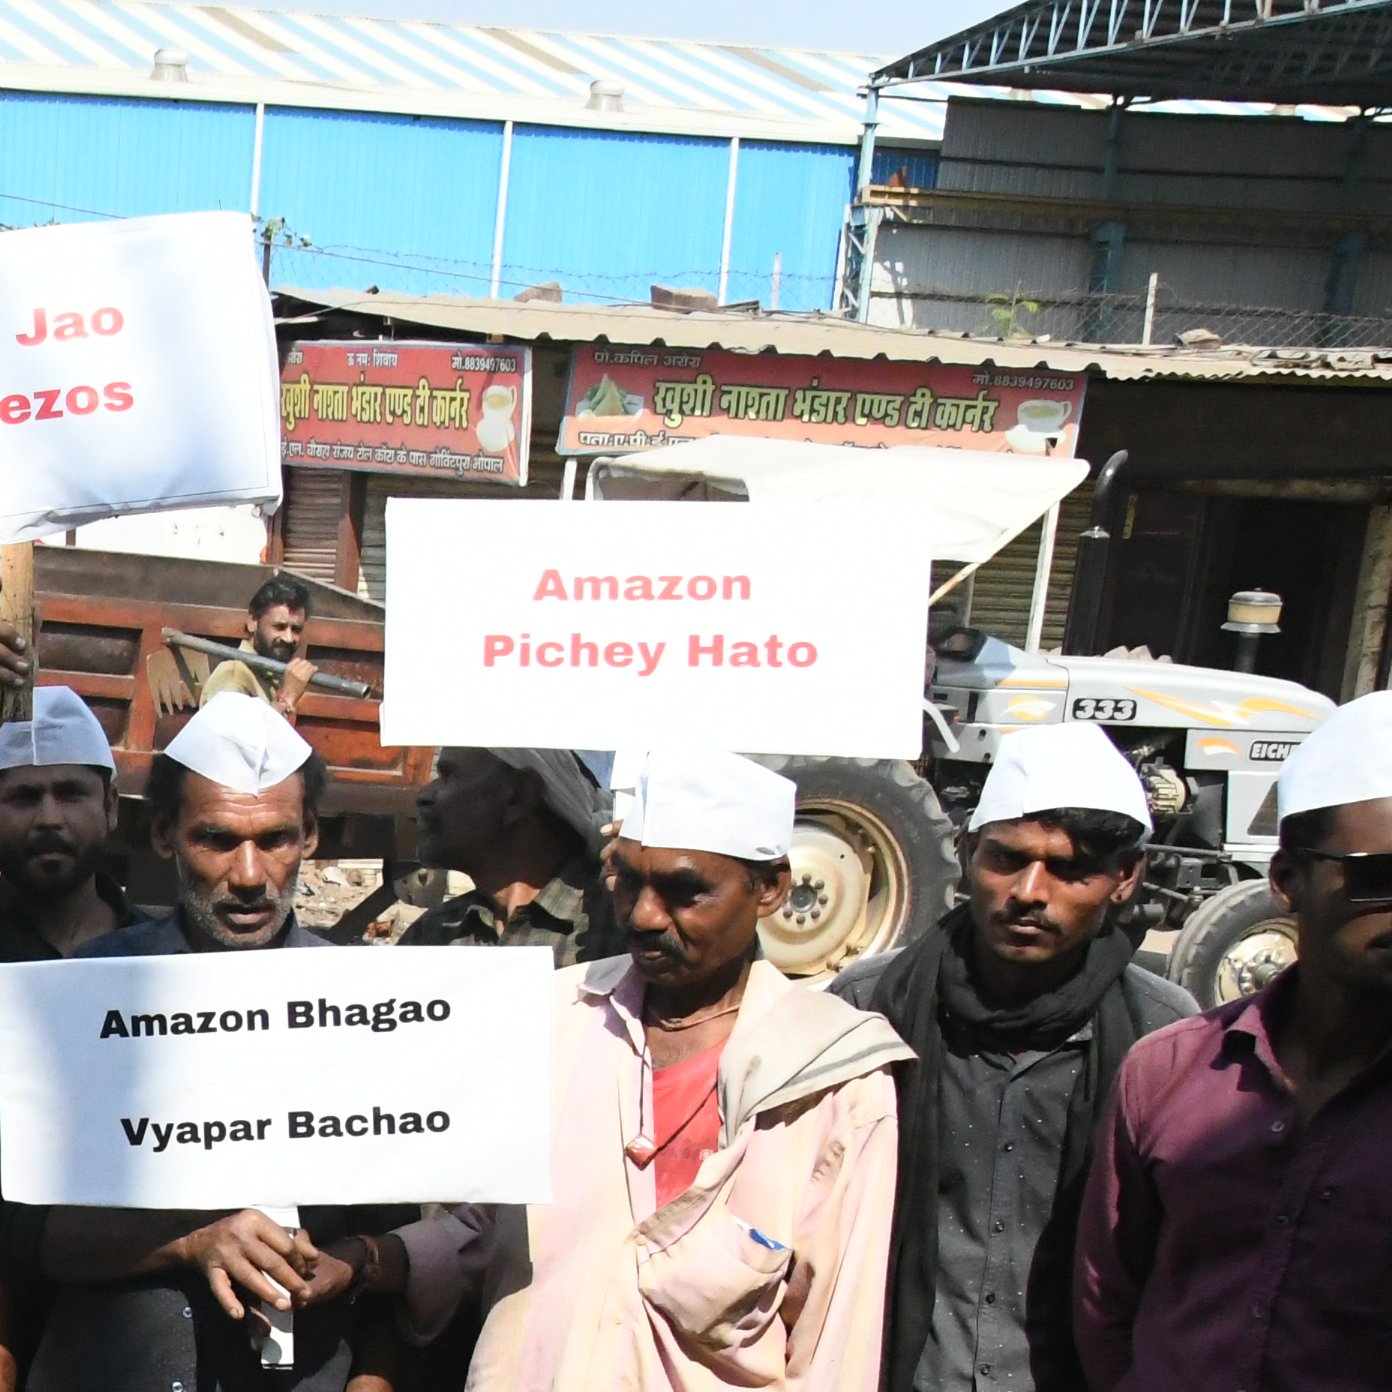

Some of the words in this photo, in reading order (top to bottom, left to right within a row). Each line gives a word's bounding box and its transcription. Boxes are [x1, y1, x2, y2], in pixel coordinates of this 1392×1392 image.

[16, 306, 124, 347] Jao
[373, 348, 398, 368] शिवाय
[451, 353, 517, 372] मो.8839497603
[663, 353, 701, 368] अरोरा
[972, 371, 1074, 391] मो.8839497603
[281, 373, 311, 431] खुशी
[313, 383, 348, 421] नाश्ता
[351, 372, 384, 424] भंडार
[385, 386, 413, 426] एण्ड
[415, 377, 431, 427] टी
[432, 377, 470, 430] कार्नर
[654, 373, 715, 428] खुशी
[720, 383, 789, 421] नाश्ता
[793, 377, 852, 424] भंडार
[854, 391, 904, 427] एण्ड
[906, 387, 934, 430] टी
[935, 389, 999, 433] कार्नर
[332, 439, 354, 460] संजय
[396, 442, 407, 463] के
[409, 450, 427, 466] पास
[472, 452, 504, 473] भोपाल
[533, 568, 751, 602] Amazon
[482, 633, 668, 677] Pichey
[686, 632, 818, 670] Hato
[1075, 699, 1136, 720] 333
[99, 1005, 269, 1039] Amazon
[287, 998, 451, 1032] Bhagao
[120, 1116, 272, 1152] Vyapar
[288, 1106, 451, 1139] Bachao
